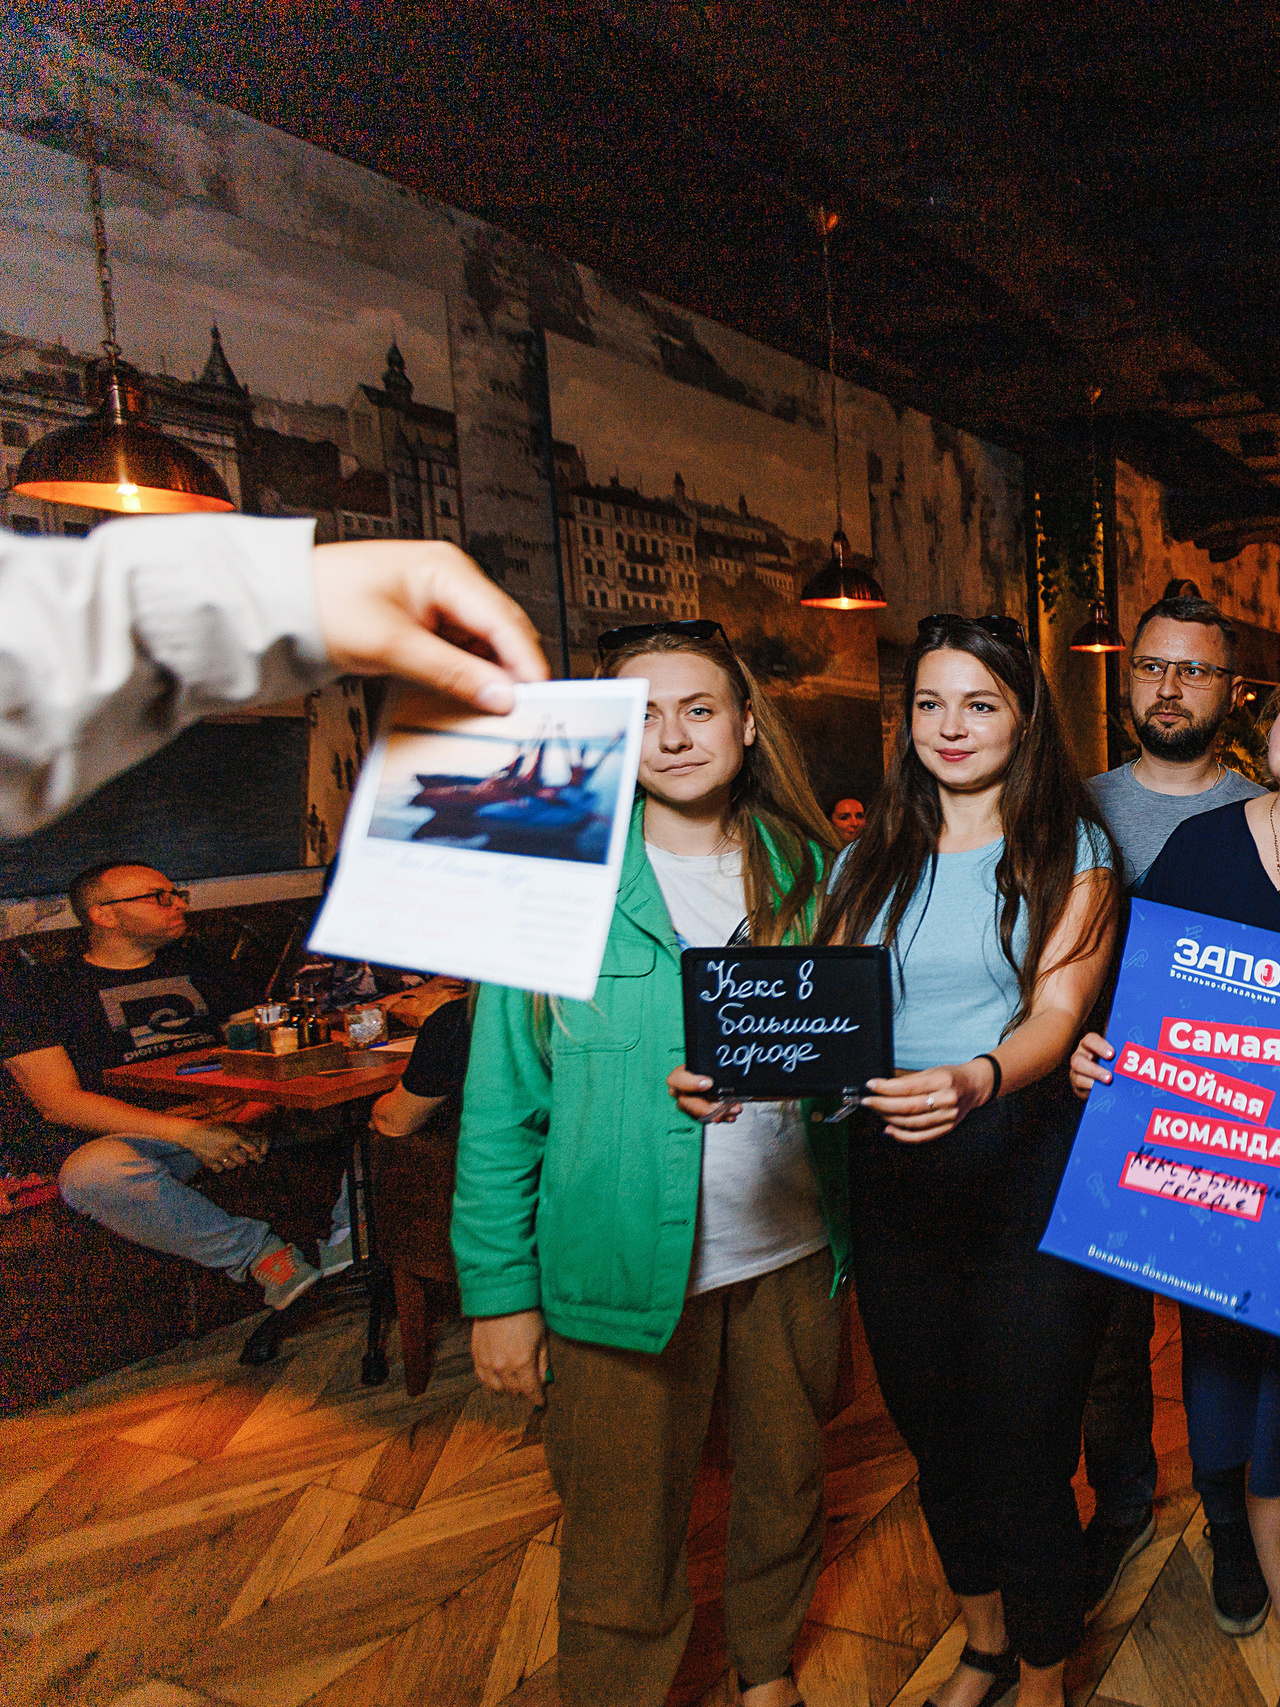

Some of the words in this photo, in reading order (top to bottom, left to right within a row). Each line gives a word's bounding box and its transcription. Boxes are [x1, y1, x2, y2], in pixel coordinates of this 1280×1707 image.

[700, 959, 787, 1002] Кекс
[715, 1042, 822, 1077] городе
[1123, 1050, 1265, 1118] ЗАПОЙная
[1203, 1286, 1229, 1306] квиз
